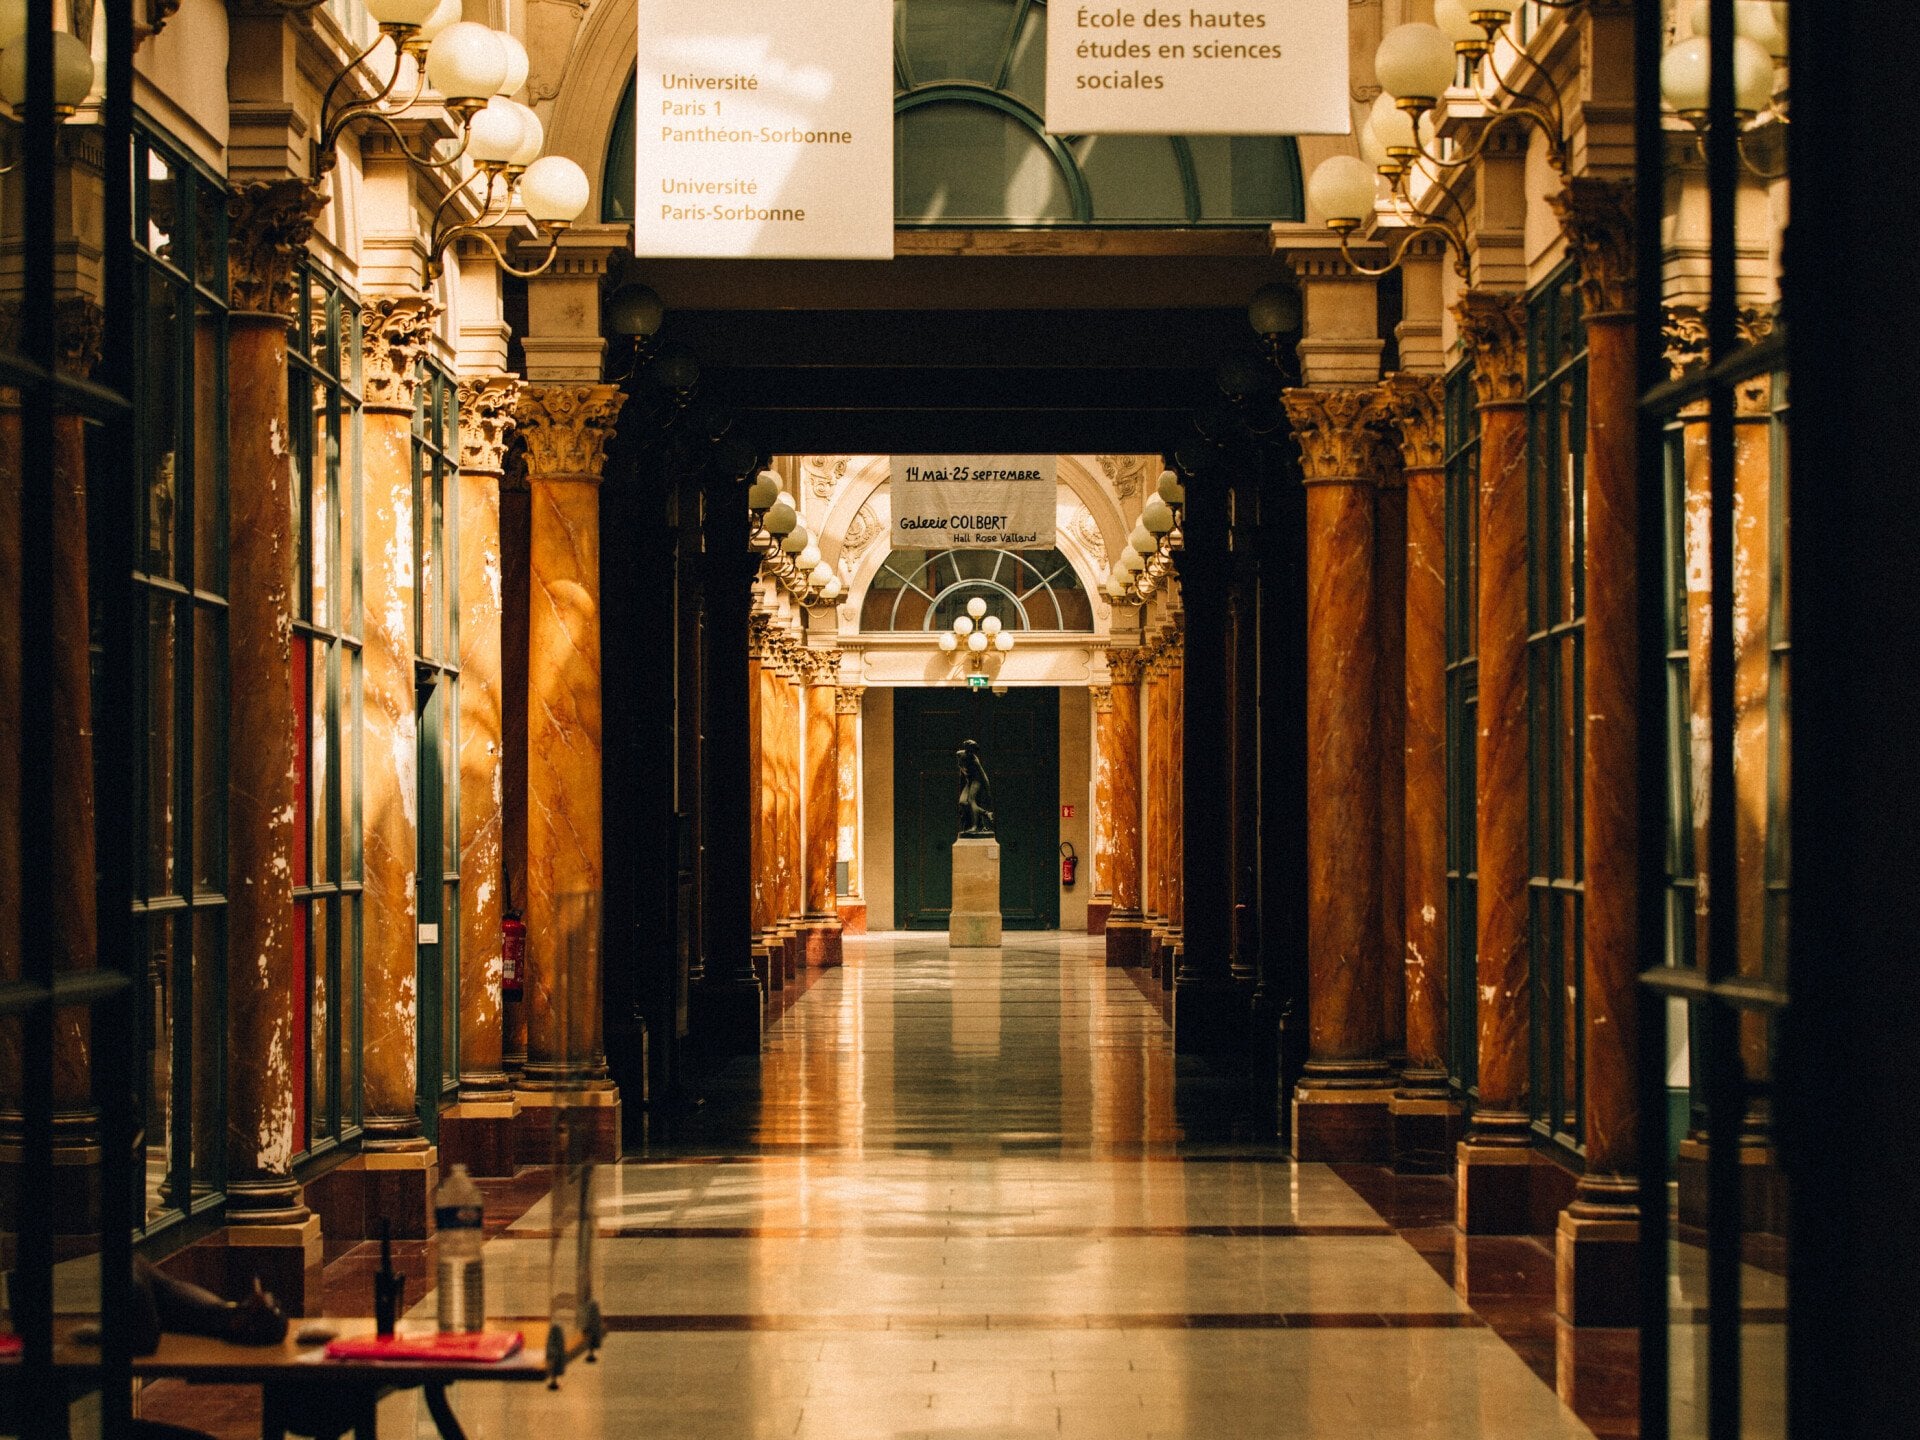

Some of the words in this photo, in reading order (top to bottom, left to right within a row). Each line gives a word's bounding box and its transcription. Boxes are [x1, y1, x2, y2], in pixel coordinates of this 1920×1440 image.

[1077, 6, 1135, 28] École
[1143, 9, 1182, 28] des
[1190, 9, 1266, 28] hautes
[1076, 40, 1151, 58] études
[1158, 43, 1185, 58] en
[1192, 40, 1282, 58] sciences
[661, 74, 758, 90] Université
[1076, 70, 1164, 89] sociales
[661, 101, 706, 116] Paris
[713, 101, 722, 116] 1
[661, 126, 852, 144] Panthéon-Sorbonne
[661, 178, 757, 195] Université
[661, 204, 805, 221] Paris-Sorbonne
[906, 466, 919, 481] 14
[900, 515, 948, 530] Galerie
[953, 533, 971, 543] Hall
[975, 533, 997, 543] Rose
[1000, 531, 1037, 543] Valland
